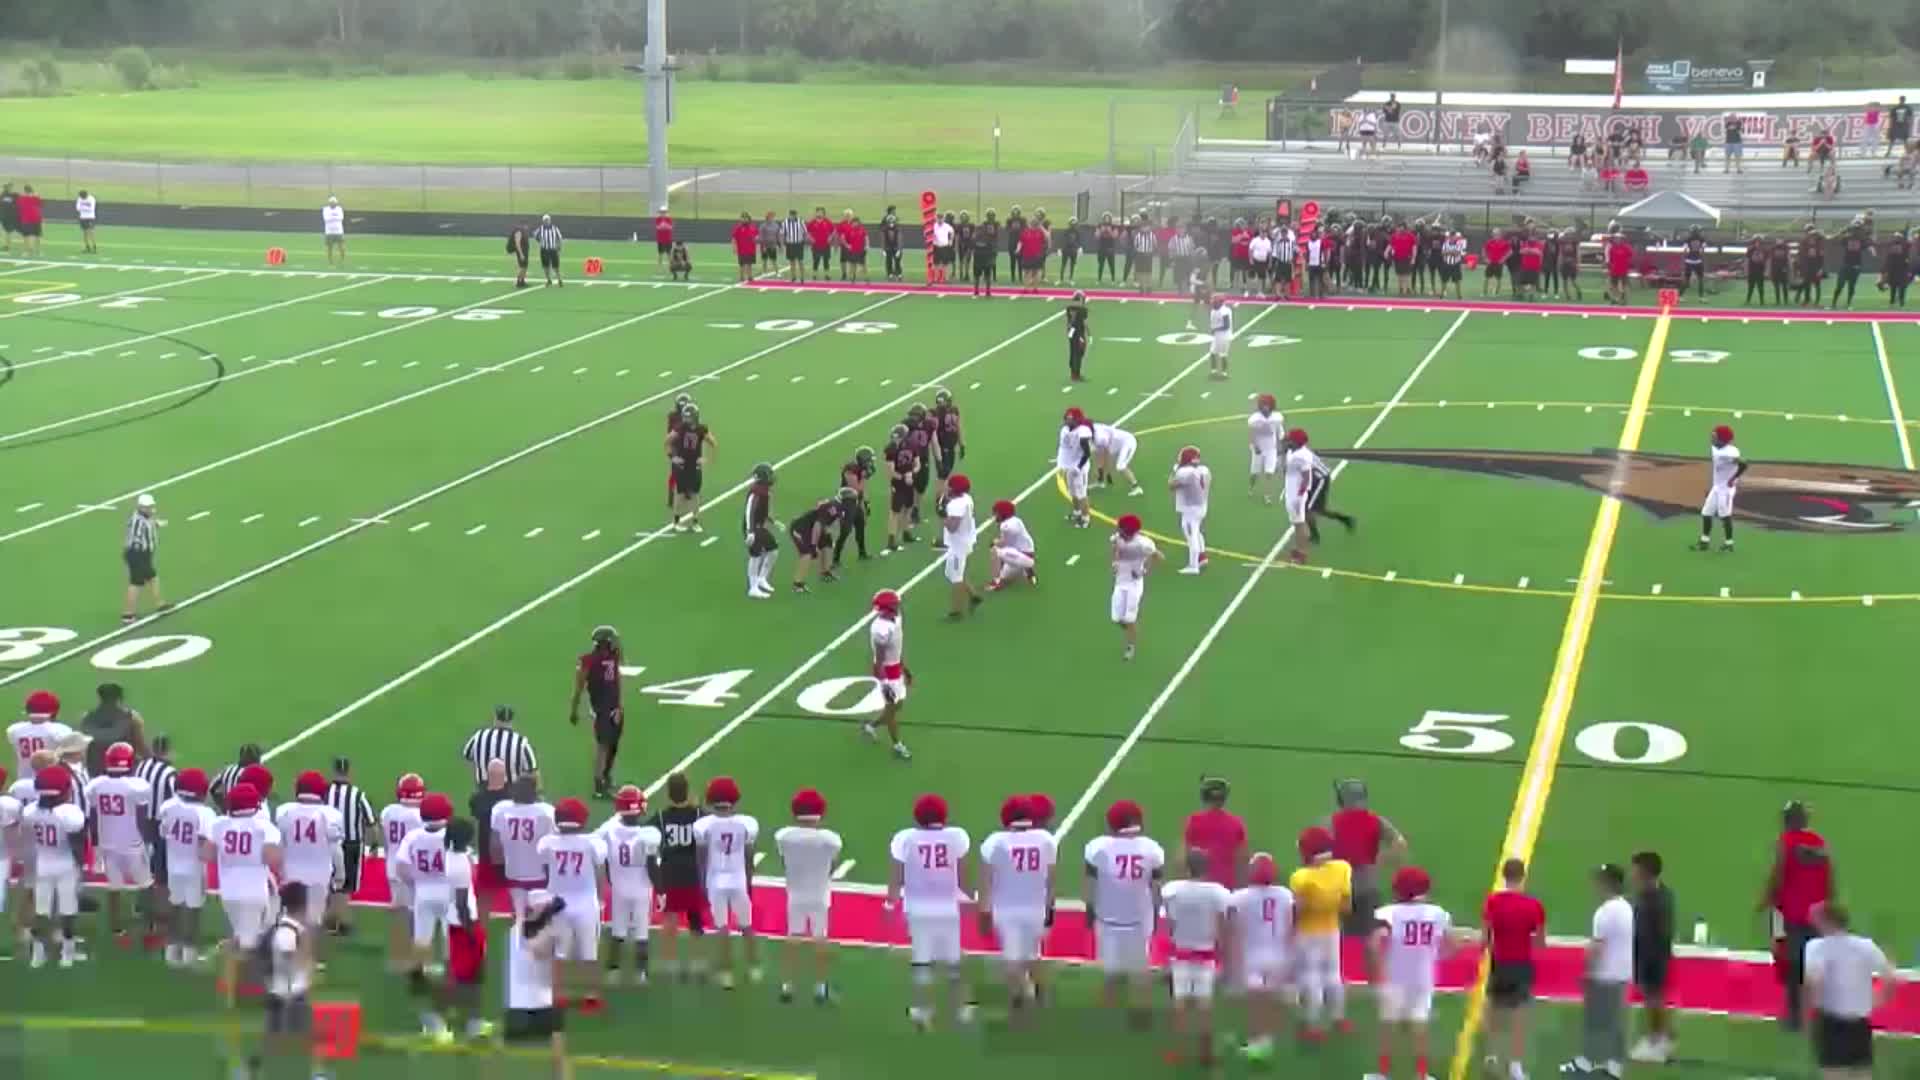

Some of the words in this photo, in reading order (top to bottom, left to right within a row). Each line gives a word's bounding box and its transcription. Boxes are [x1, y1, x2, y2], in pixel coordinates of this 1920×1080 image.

[1399, 710, 1689, 764] 50
[294, 820, 317, 844] 14
[508, 818, 535, 842] 73
[665, 823, 693, 847] 30
[224, 830, 252, 856] 90
[720, 832, 734, 857] 7
[555, 851, 584, 875] 77
